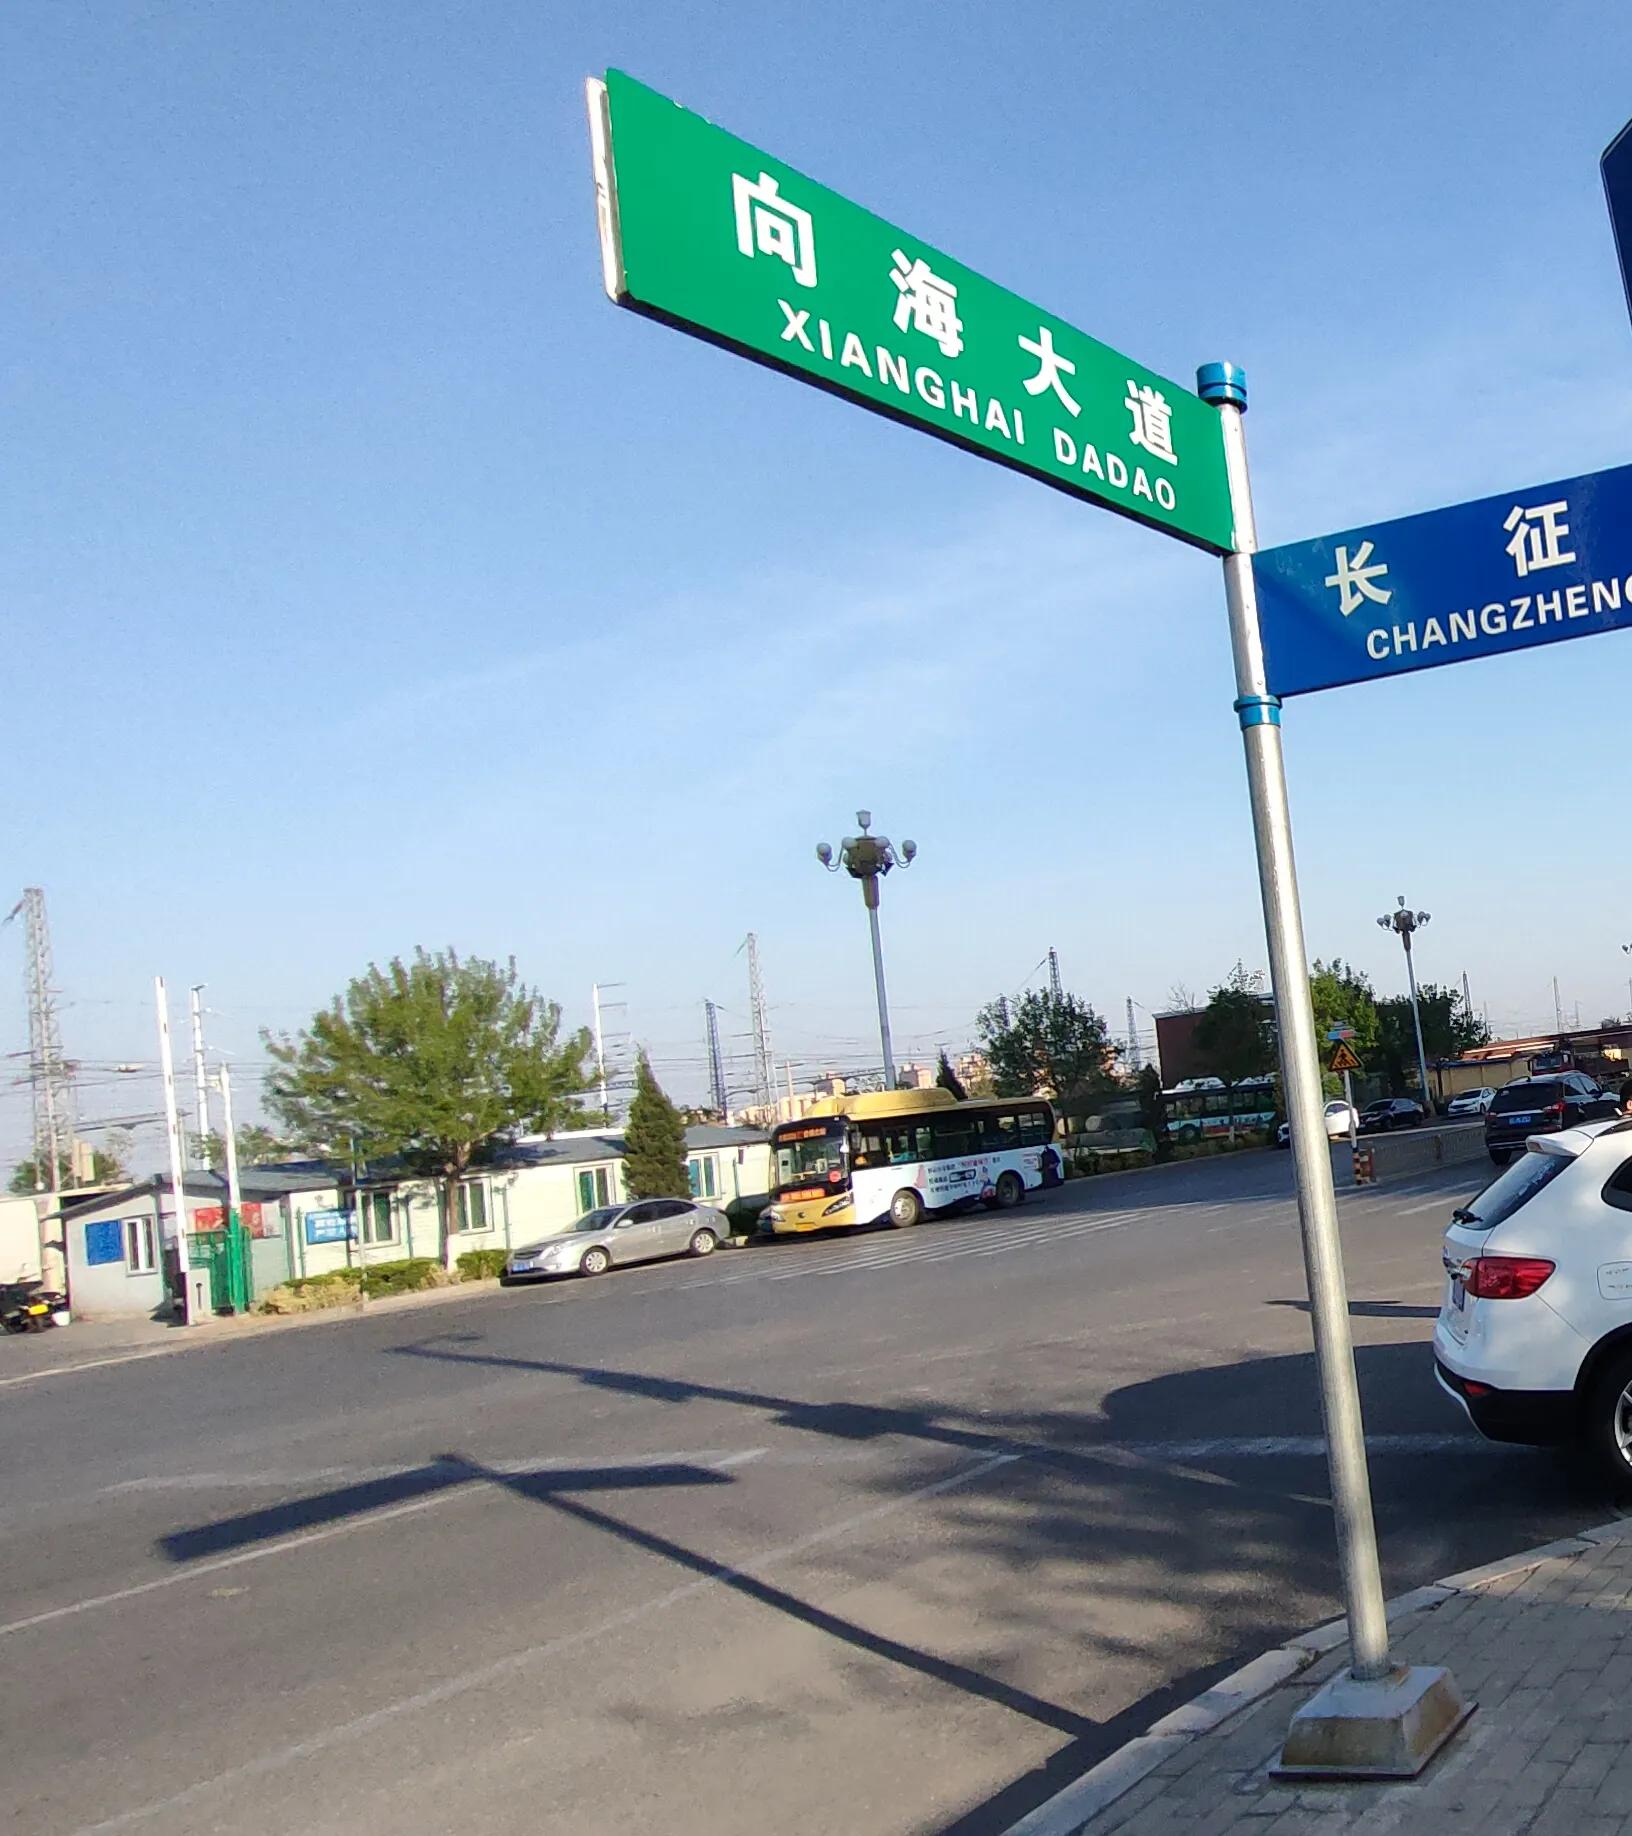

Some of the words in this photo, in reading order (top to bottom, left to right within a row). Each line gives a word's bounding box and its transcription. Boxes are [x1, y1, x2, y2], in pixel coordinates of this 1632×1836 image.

[732, 172, 1178, 465] 向海大道
[777, 298, 1025, 445] XIANGHAI
[1053, 427, 1176, 511] DADAO
